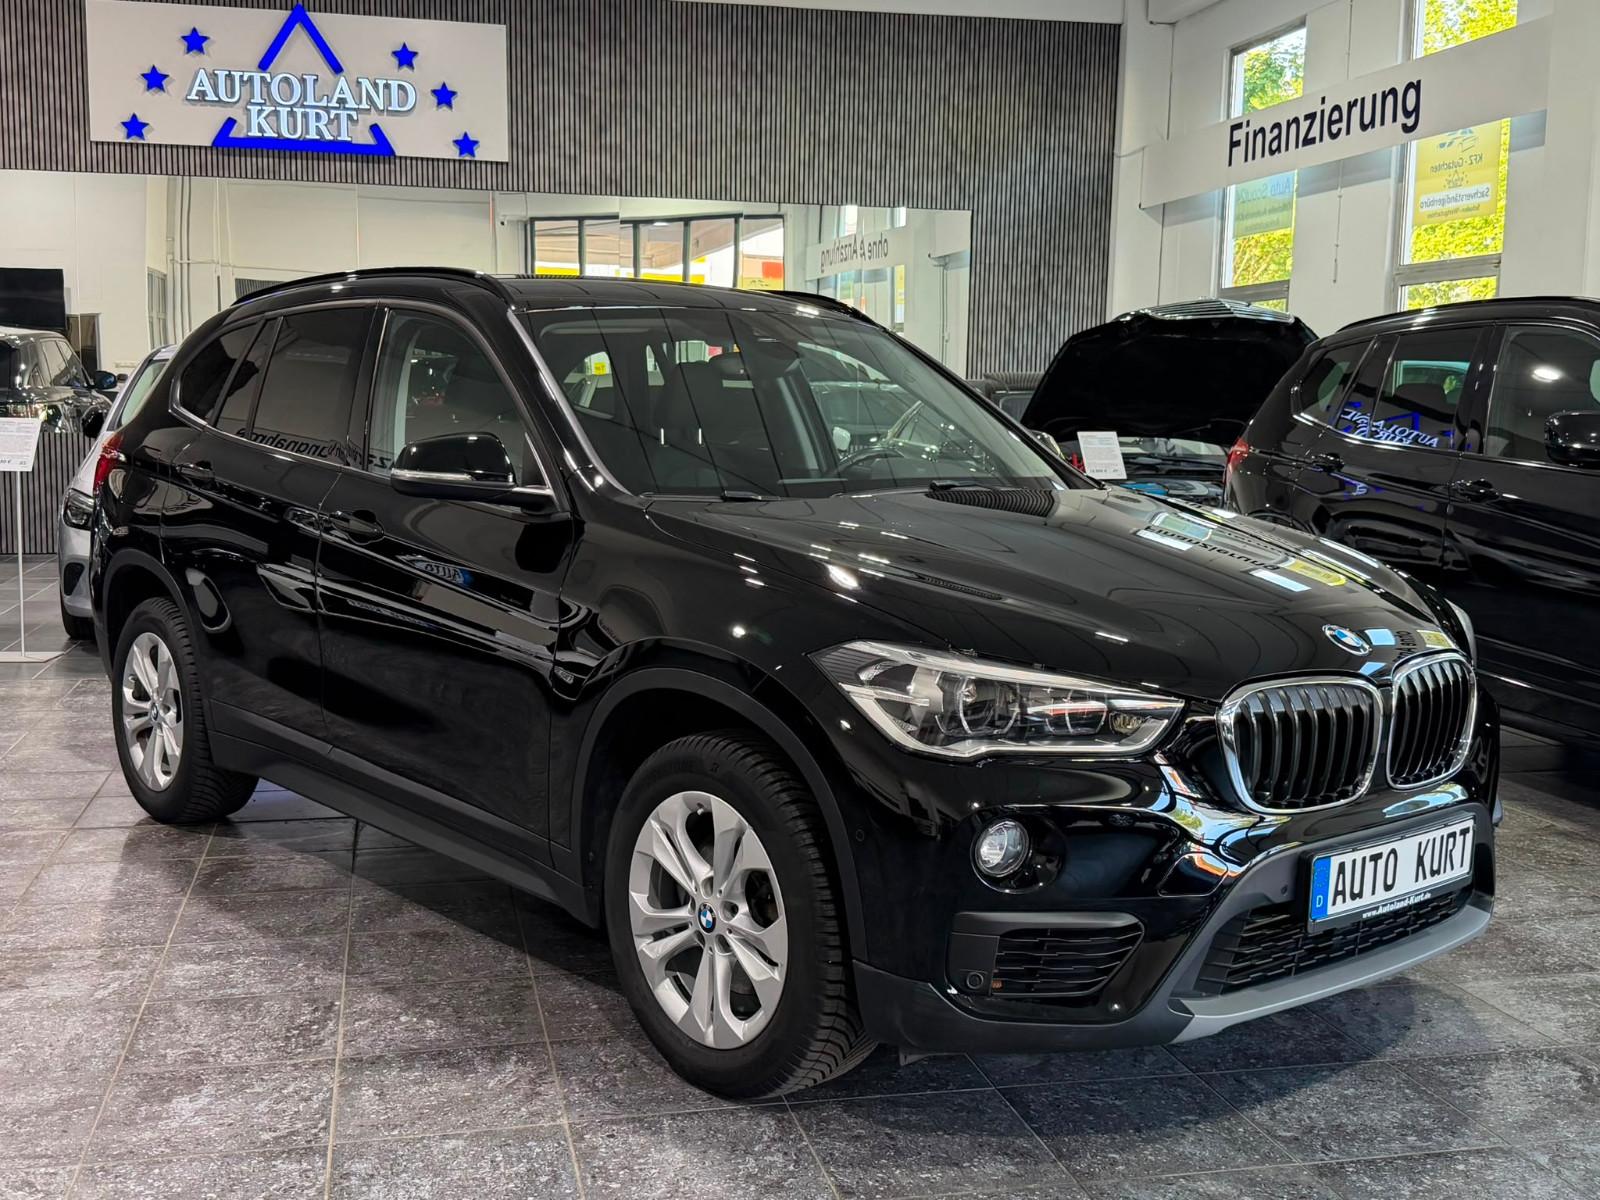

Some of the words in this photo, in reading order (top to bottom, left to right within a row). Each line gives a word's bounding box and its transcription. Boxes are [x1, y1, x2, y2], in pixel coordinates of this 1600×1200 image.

[186, 68, 417, 112] AUTOLAND
[246, 105, 358, 141] KURT
[1227, 78, 1422, 168] Finanzierung
[1315, 895, 1324, 908] D
[1332, 848, 1398, 906] AUTO
[1414, 826, 1471, 884] KURT
[1362, 892, 1432, 919] www.Autoland-Kurt.de
